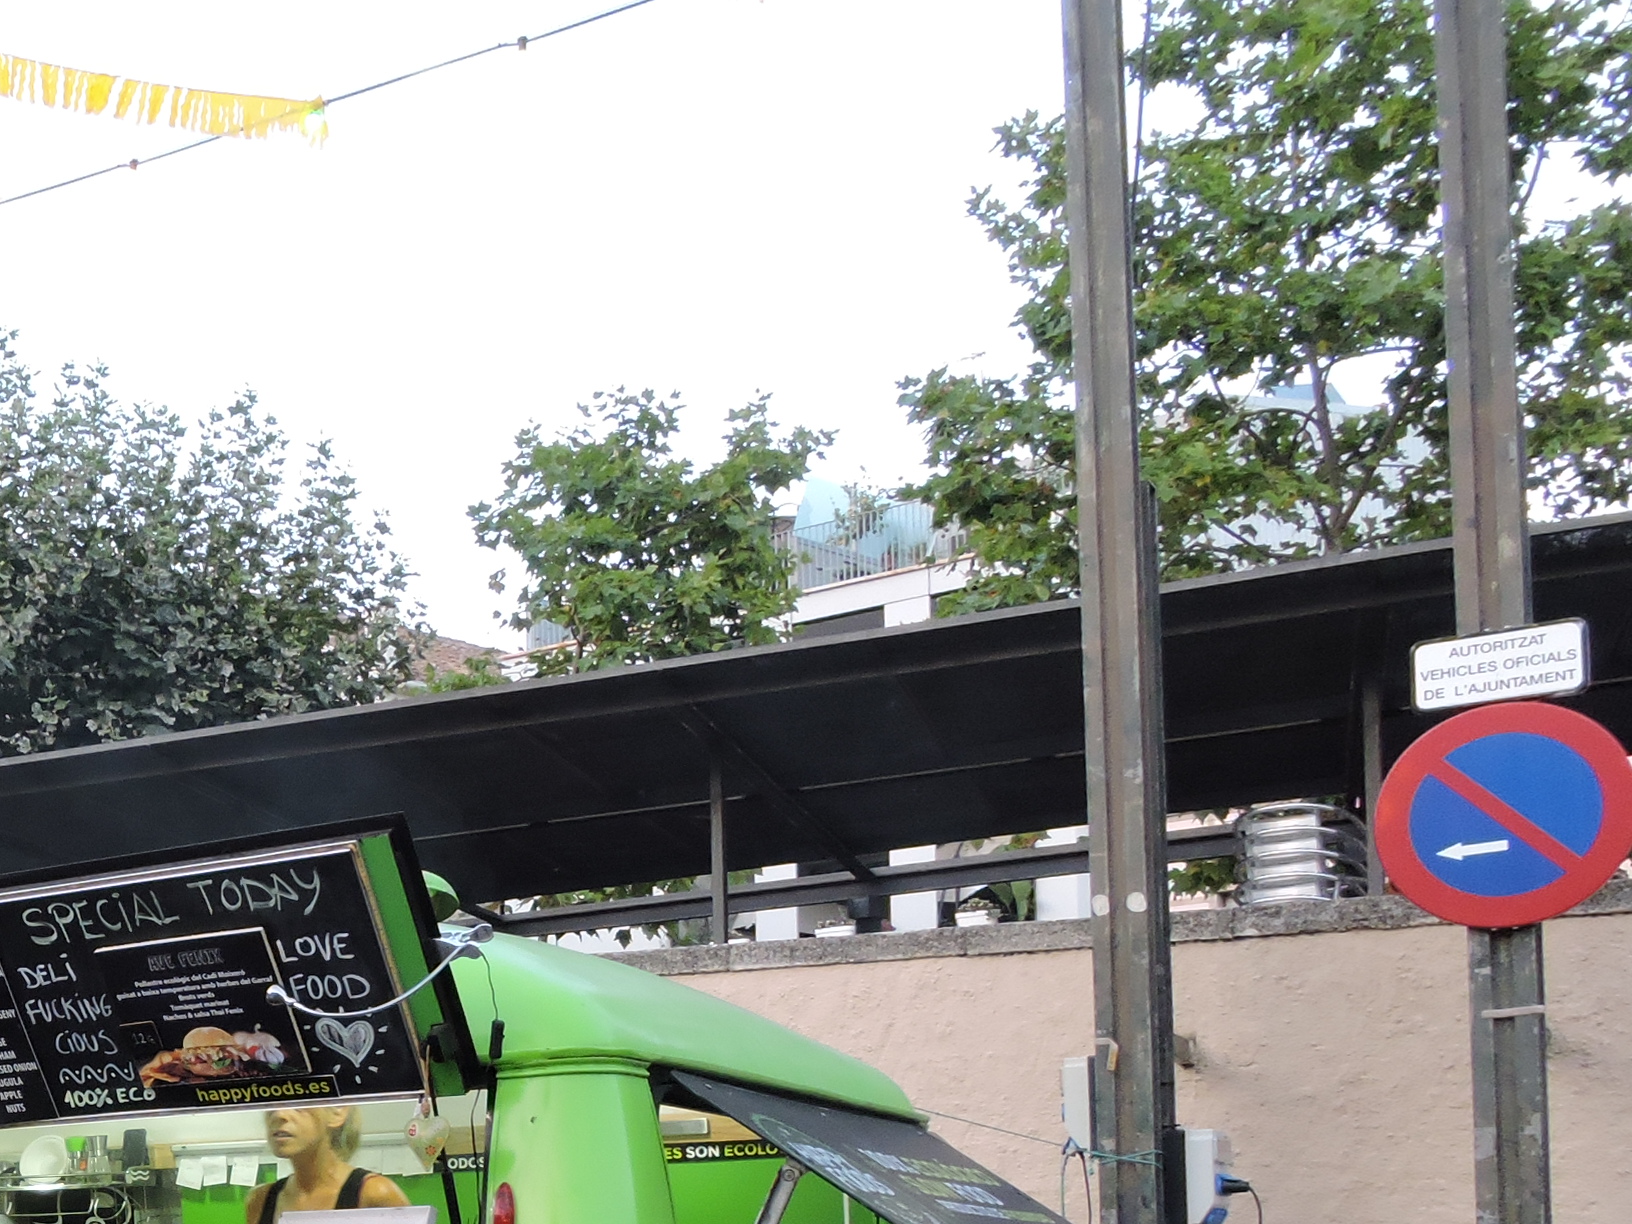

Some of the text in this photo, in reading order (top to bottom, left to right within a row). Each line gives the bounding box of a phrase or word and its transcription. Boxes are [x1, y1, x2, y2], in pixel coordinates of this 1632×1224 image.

[1449, 633, 1547, 659] AUTORITZAT
[1420, 649, 1577, 682] VEHICLES OFICIALS
[1424, 668, 1577, 701] DE L'AJUNTAMENT
[186, 868, 321, 916] TODAY
[276, 932, 355, 963] LOVE
[148, 948, 225, 971] AVE FENIX
[289, 973, 371, 1002] FOOD
[13, 1062, 38, 1072] ONION
[0, 1090, 24, 1101] APPLE
[64, 1087, 156, 1109] 100% ECO
[196, 1080, 330, 1104] happyfoods.es
[5, 1103, 27, 1114] NUTS
[447, 1156, 485, 1169] ODOS
[686, 1145, 720, 1159] SON
